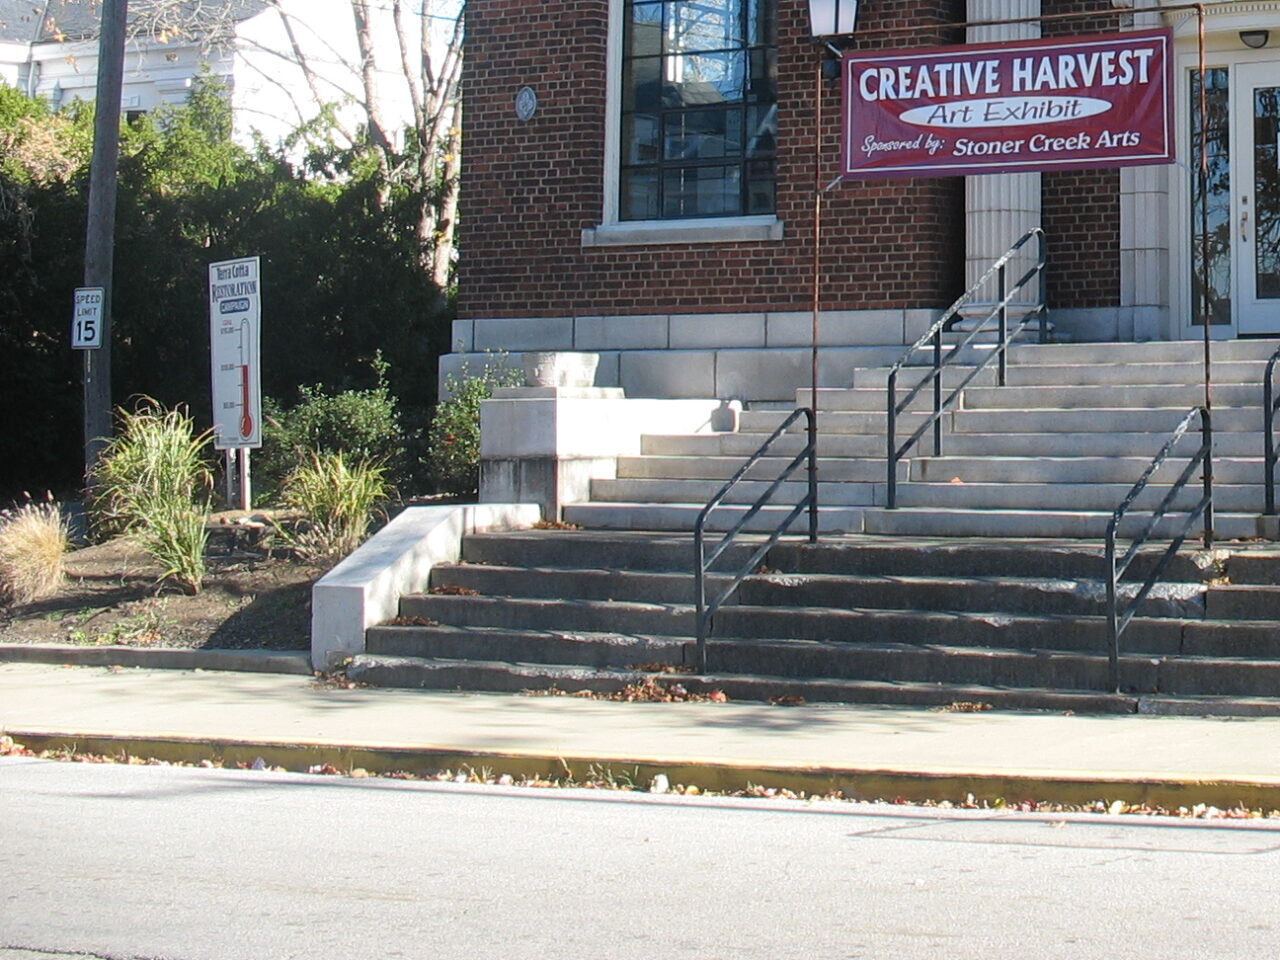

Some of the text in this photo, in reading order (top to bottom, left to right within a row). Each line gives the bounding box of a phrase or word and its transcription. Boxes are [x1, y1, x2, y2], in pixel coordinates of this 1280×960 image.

[858, 48, 1155, 102] CREATIVE HARVEST
[926, 98, 1082, 125] Art Exhibit
[861, 129, 1141, 158] Sponsored by: Stoner Creek Arts
[75, 294, 101, 304] SPEED
[77, 307, 97, 316] LIMIT
[76, 320, 96, 341] 15
